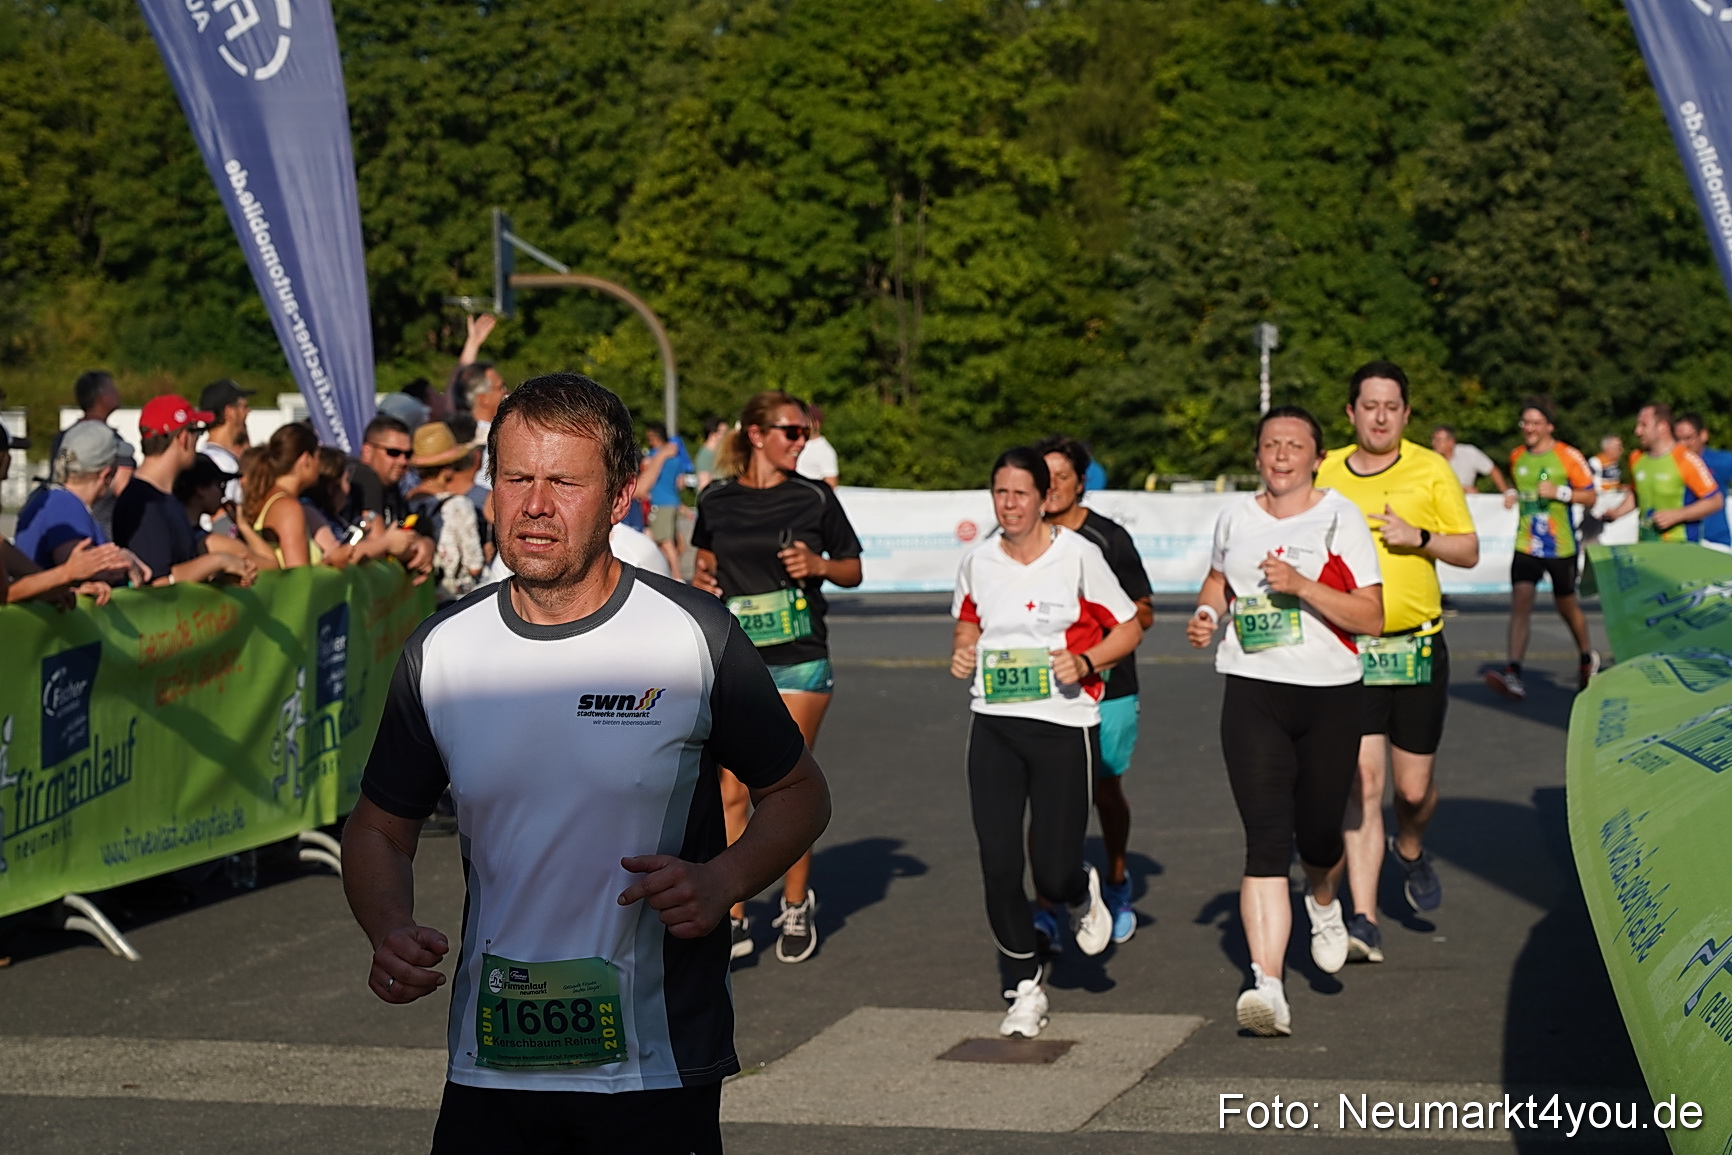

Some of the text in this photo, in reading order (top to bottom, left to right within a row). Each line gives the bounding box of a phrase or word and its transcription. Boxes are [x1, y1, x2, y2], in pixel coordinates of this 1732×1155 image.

[741, 611, 775, 631] 283
[1244, 611, 1283, 633] 932
[996, 666, 1030, 686] 931
[577, 694, 636, 710] swn
[576, 710, 615, 718] stadtwerke
[15, 716, 137, 836] firmenlauf
[482, 1007, 493, 1046] RUN
[494, 998, 596, 1035] 1668
[598, 1002, 618, 1050] 2022
[492, 1036, 602, 1048] Kerschbaum Reiner
